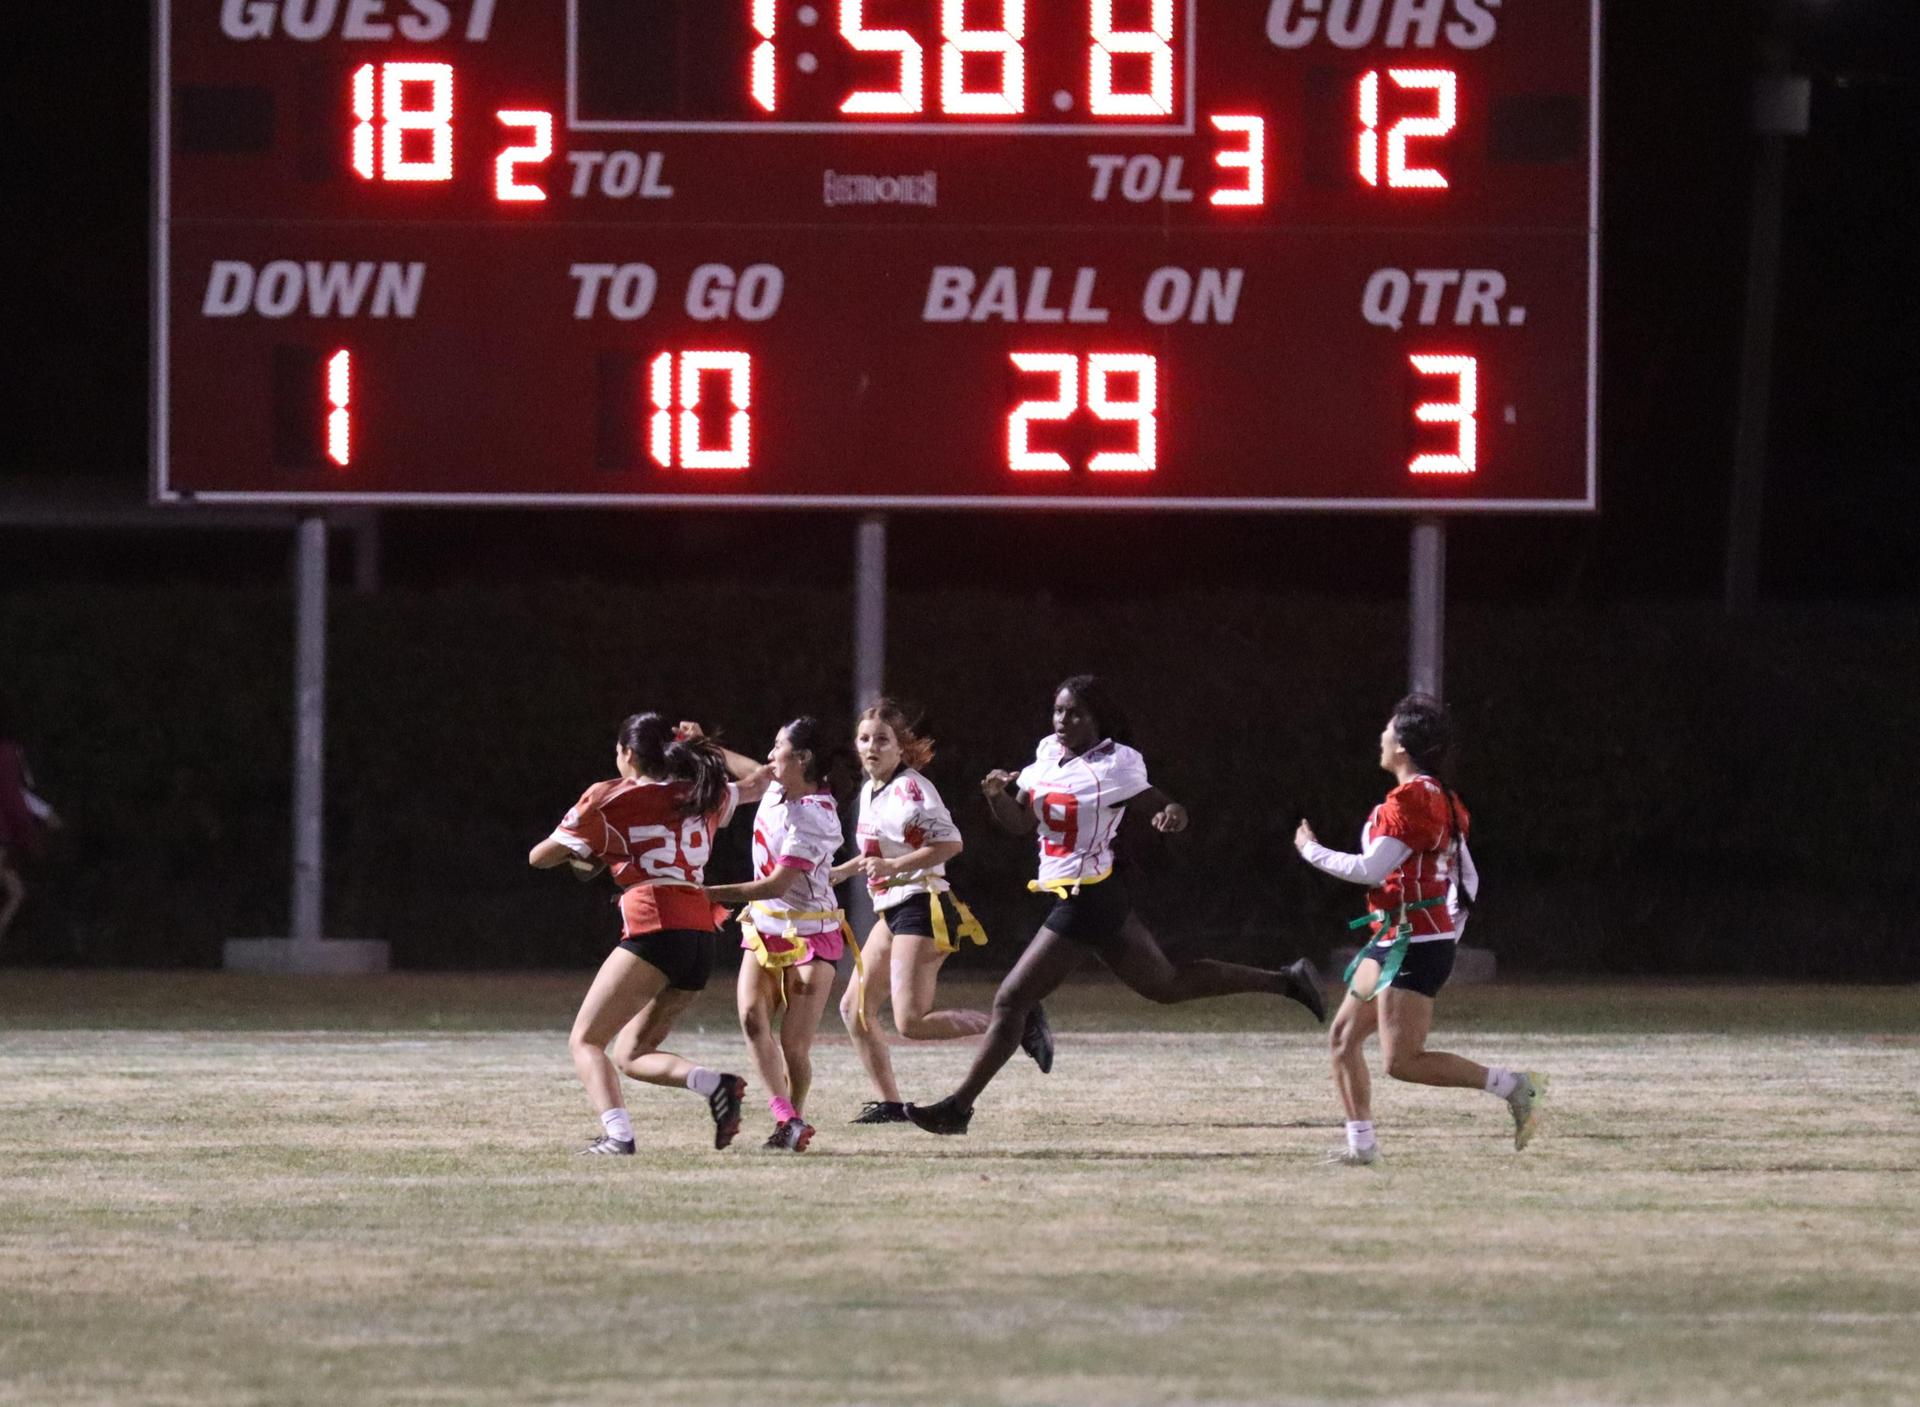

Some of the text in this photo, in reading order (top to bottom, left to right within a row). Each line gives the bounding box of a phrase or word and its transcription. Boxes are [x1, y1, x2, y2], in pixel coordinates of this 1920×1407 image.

[220, 0, 495, 41] GUEST
[352, 62, 454, 182] 18
[495, 110, 553, 201] 2
[1210, 115, 1265, 206] 3
[1358, 69, 1457, 188] 12
[567, 151, 674, 198] TOL
[1088, 155, 1194, 202] TOL
[202, 260, 426, 318] DOWN
[569, 263, 785, 321] TO GO
[922, 266, 1244, 324] BALL ON
[1361, 268, 1527, 331] QTR.
[328, 349, 350, 466] 1
[651, 350, 751, 469] 10
[1008, 352, 1157, 472] 29
[1409, 354, 1477, 474] 3
[628, 814, 712, 883] 29
